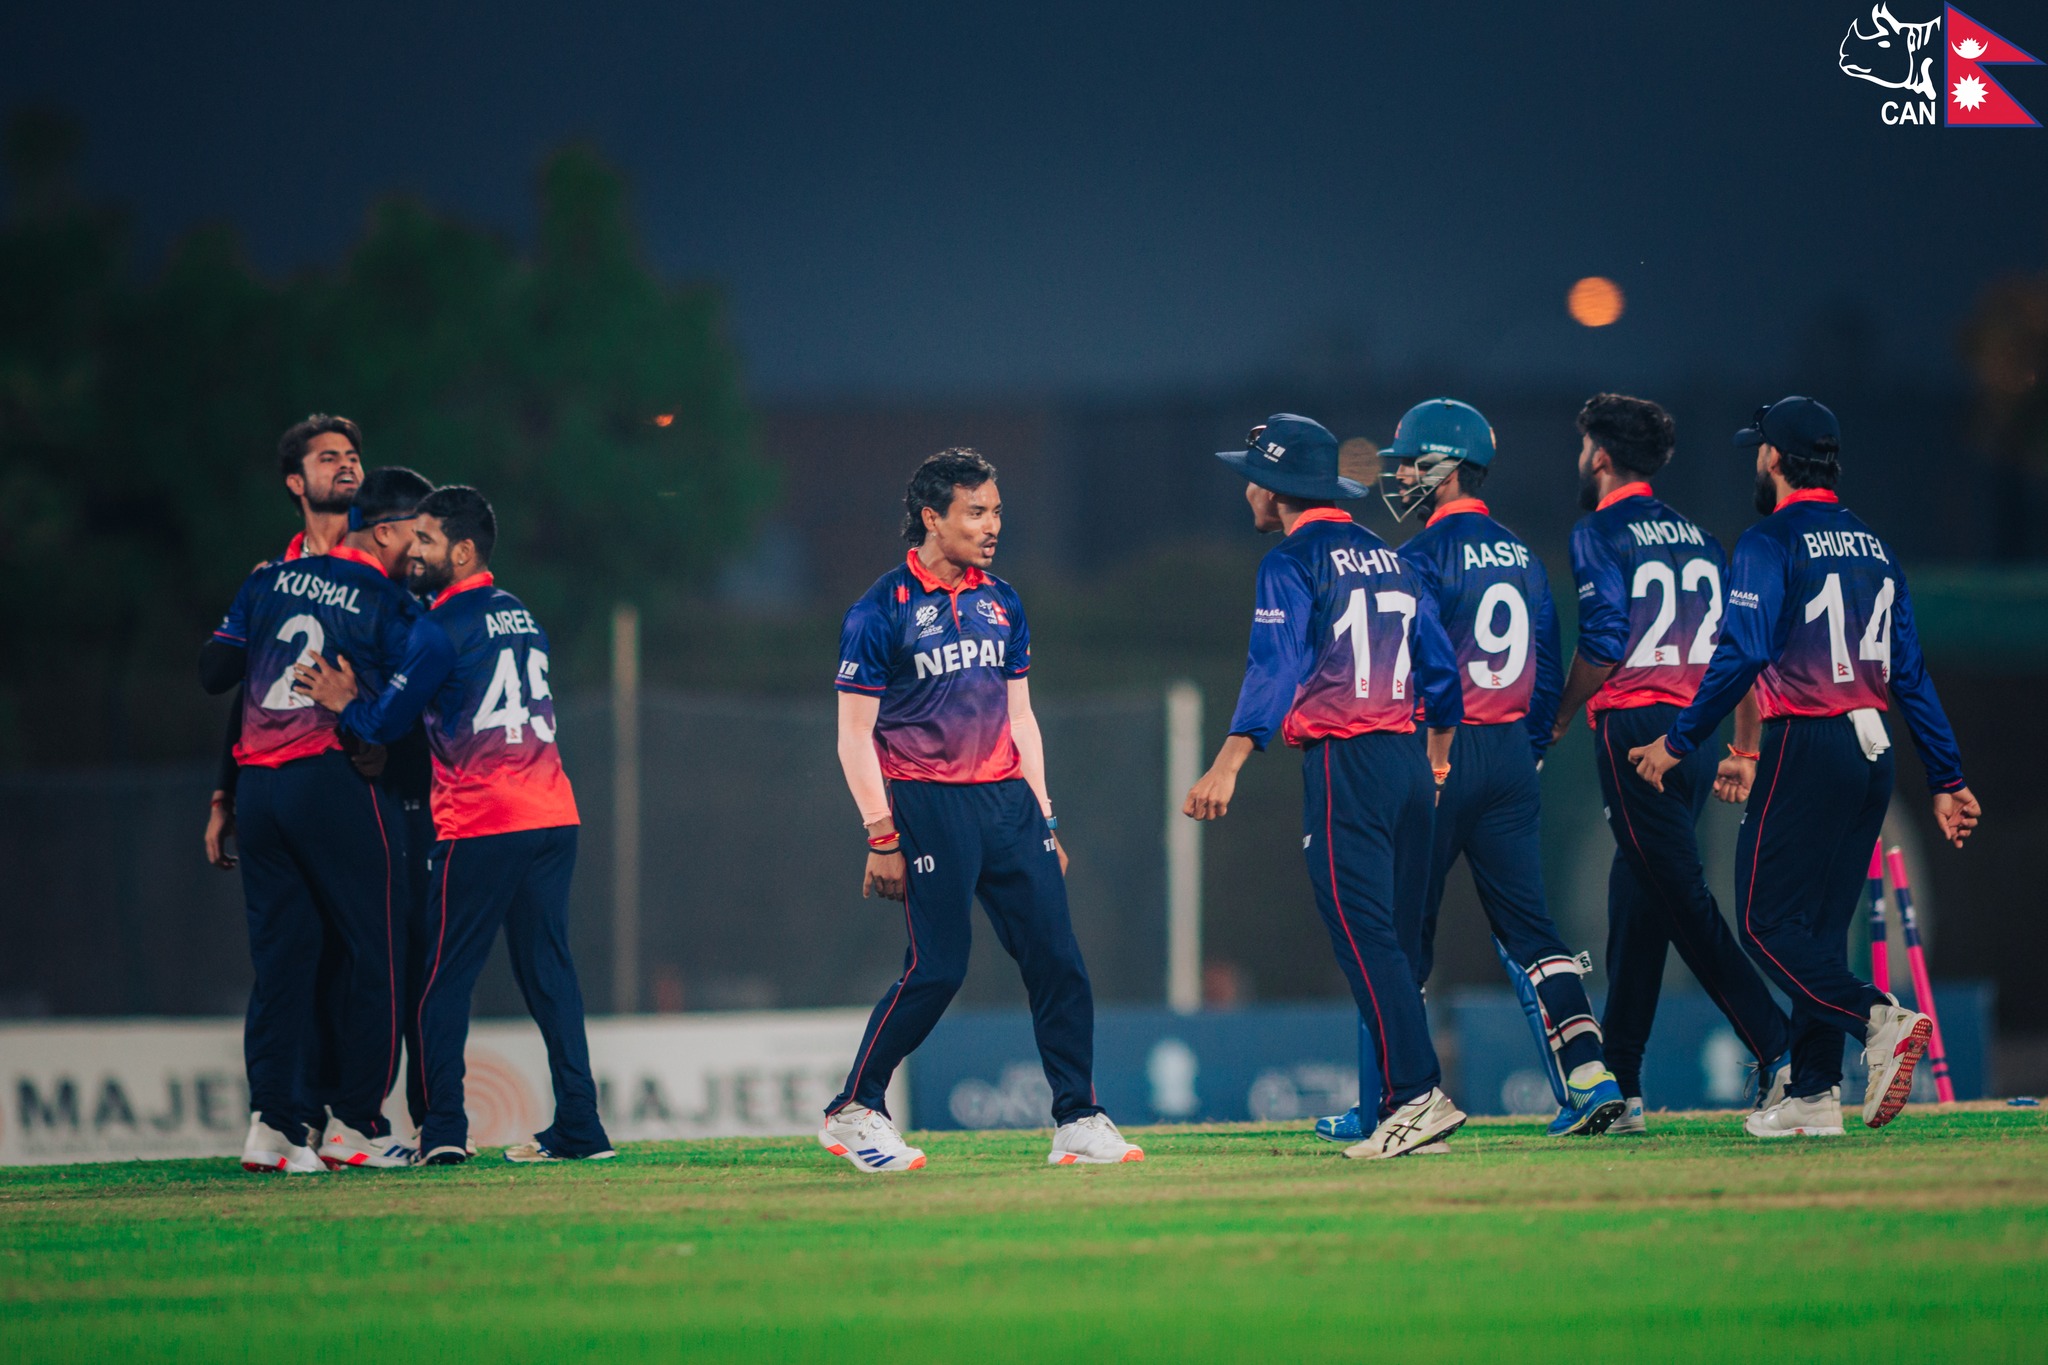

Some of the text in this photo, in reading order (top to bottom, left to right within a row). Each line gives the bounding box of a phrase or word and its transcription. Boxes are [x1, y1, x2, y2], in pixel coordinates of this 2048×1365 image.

[1628, 520, 1704, 547] NANDAN
[1804, 531, 1889, 565] BHURTEL
[1463, 541, 1529, 570] AASIF
[273, 570, 362, 614] KUSHAL
[1625, 558, 1723, 668] 22
[1730, 589, 1759, 601] NAASA
[485, 609, 539, 639] AIREE
[1255, 609, 1285, 618] NAASA
[1805, 573, 1895, 683] 14
[1333, 588, 1416, 699] 17
[1468, 582, 1530, 689] 9
[261, 614, 325, 710] 2
[913, 639, 1005, 679] NEPAL
[472, 647, 557, 744] 45
[913, 854, 935, 874] 10
[17, 1074, 251, 1131] MAJE
